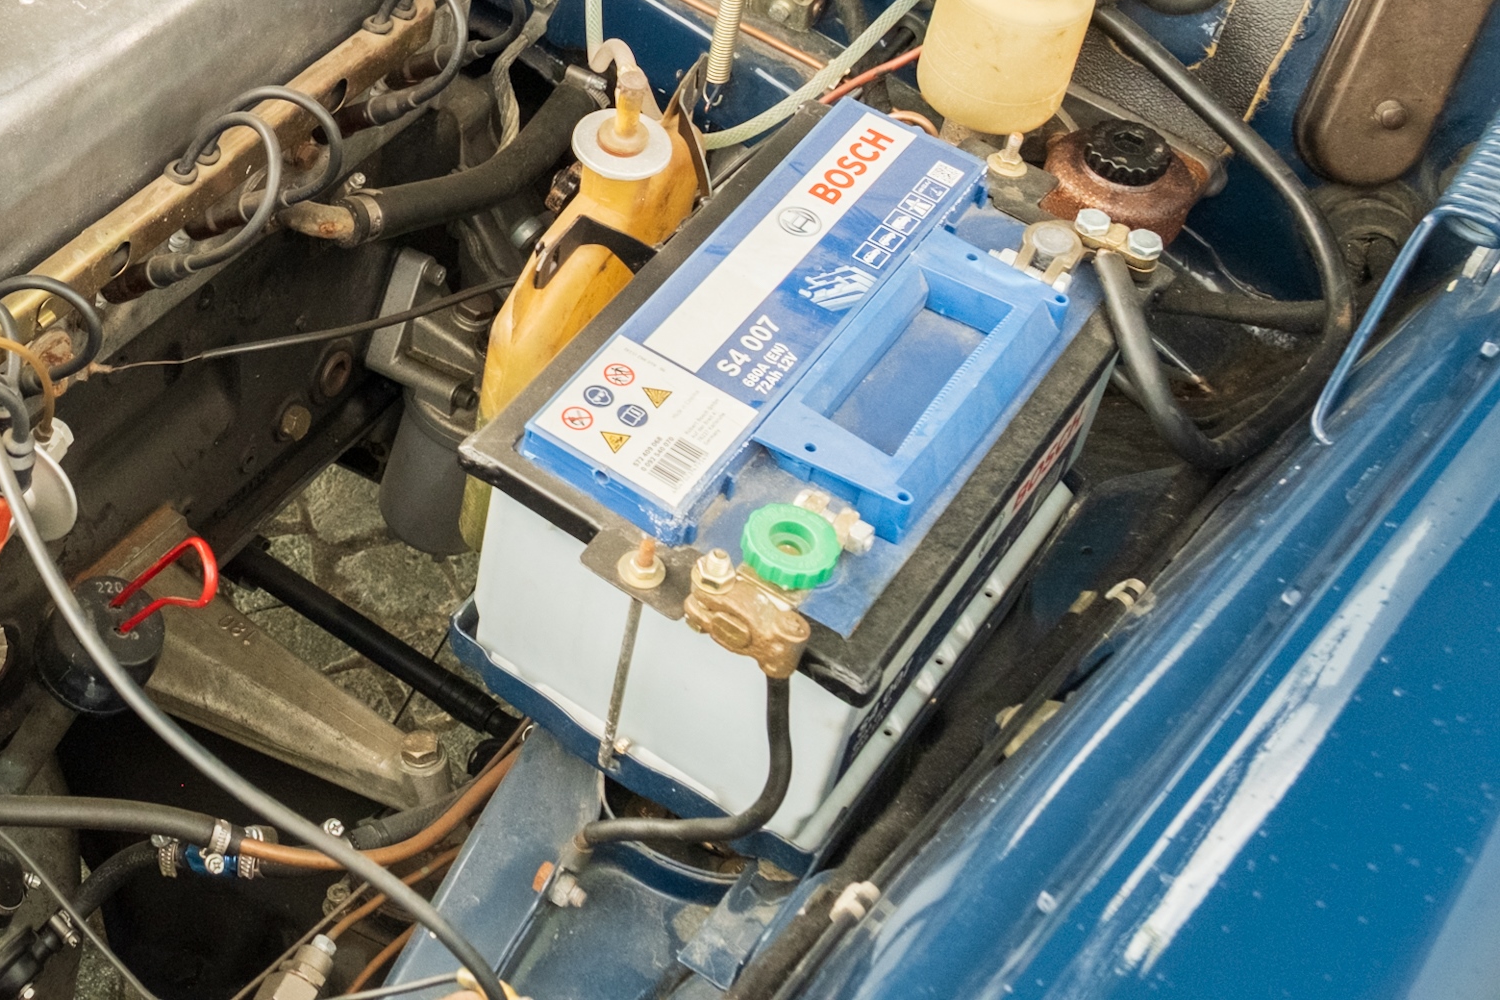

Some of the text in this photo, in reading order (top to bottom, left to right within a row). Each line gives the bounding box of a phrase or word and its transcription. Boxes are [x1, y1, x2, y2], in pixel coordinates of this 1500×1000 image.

[807, 128, 895, 206] BOSCH
[716, 314, 781, 378] S4 007
[743, 342, 788, 389] 680A (EN)
[755, 353, 799, 395] 72Ah 12V
[640, 445, 654, 457] 409
[650, 435, 663, 447] 068
[643, 456, 657, 467] 092
[662, 435, 675, 447] 070
[1012, 404, 1087, 514] BOSCH
[95, 581, 124, 594] 220
